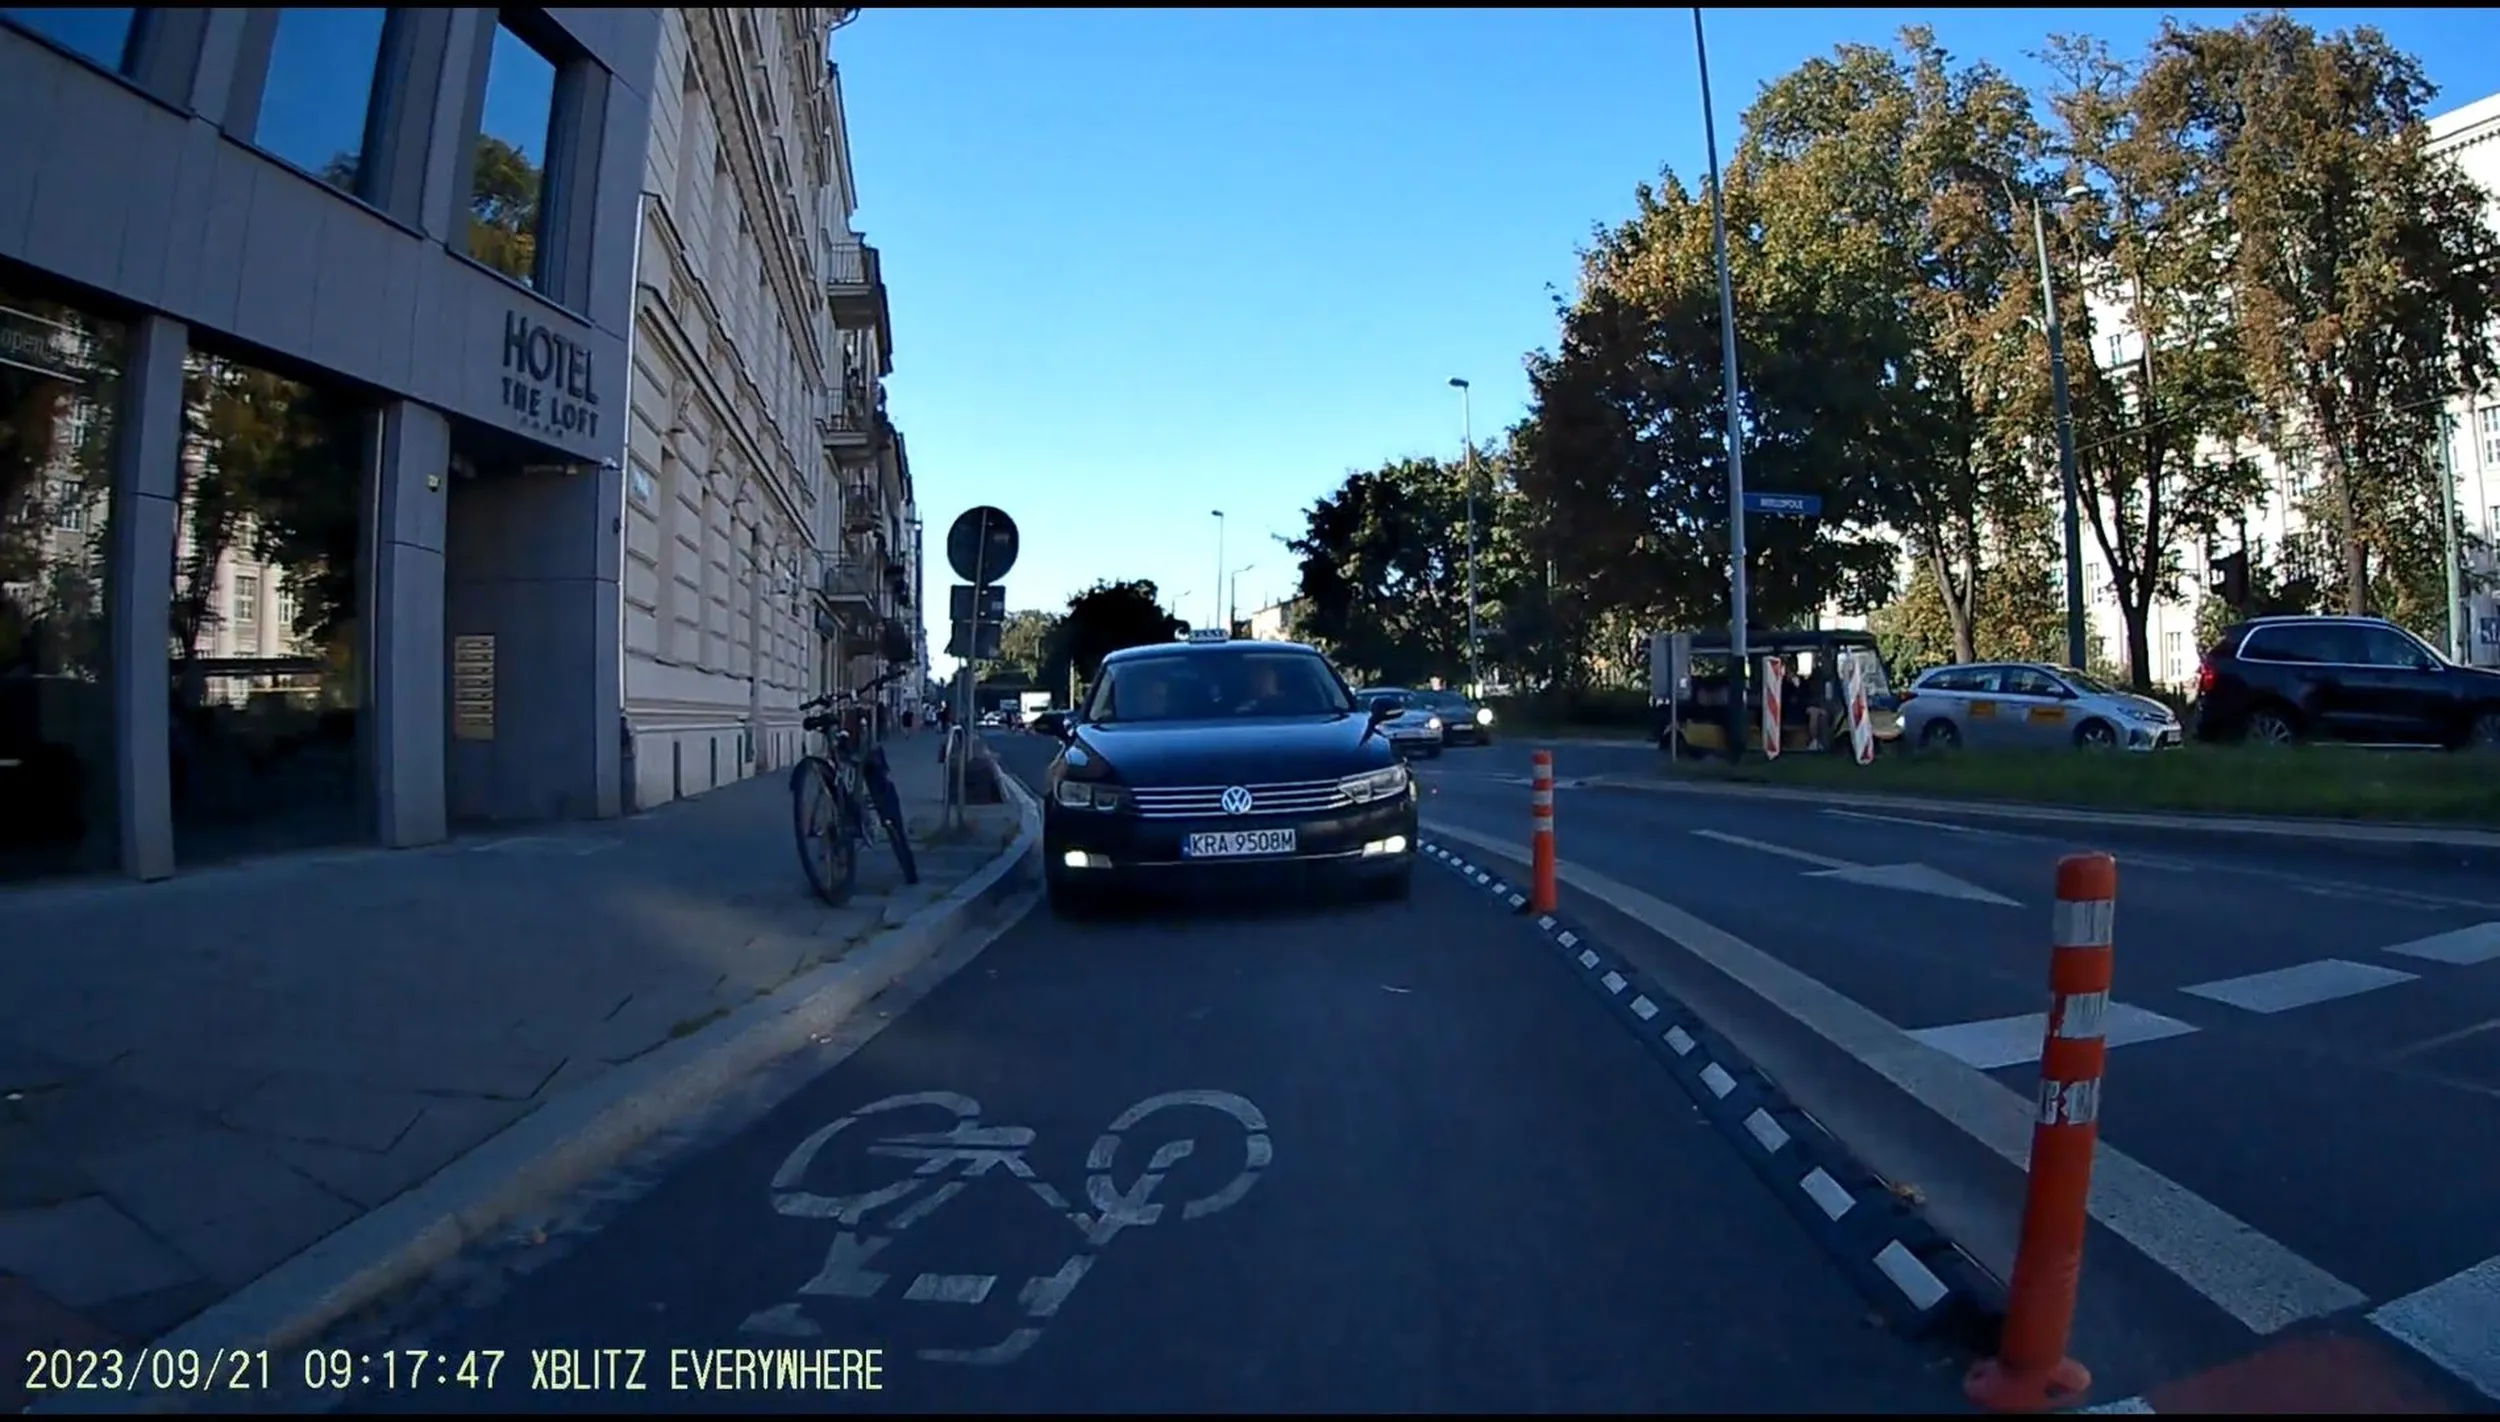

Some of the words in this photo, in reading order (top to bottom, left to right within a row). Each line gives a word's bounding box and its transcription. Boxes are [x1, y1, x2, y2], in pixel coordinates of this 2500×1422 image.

[503, 309, 600, 405] HOTEL
[502, 376, 541, 417] THE
[551, 395, 599, 439] LOFT
[1221, 785, 1252, 815] VW
[1191, 833, 1229, 854] KRA
[1235, 830, 1294, 852] 9508M
